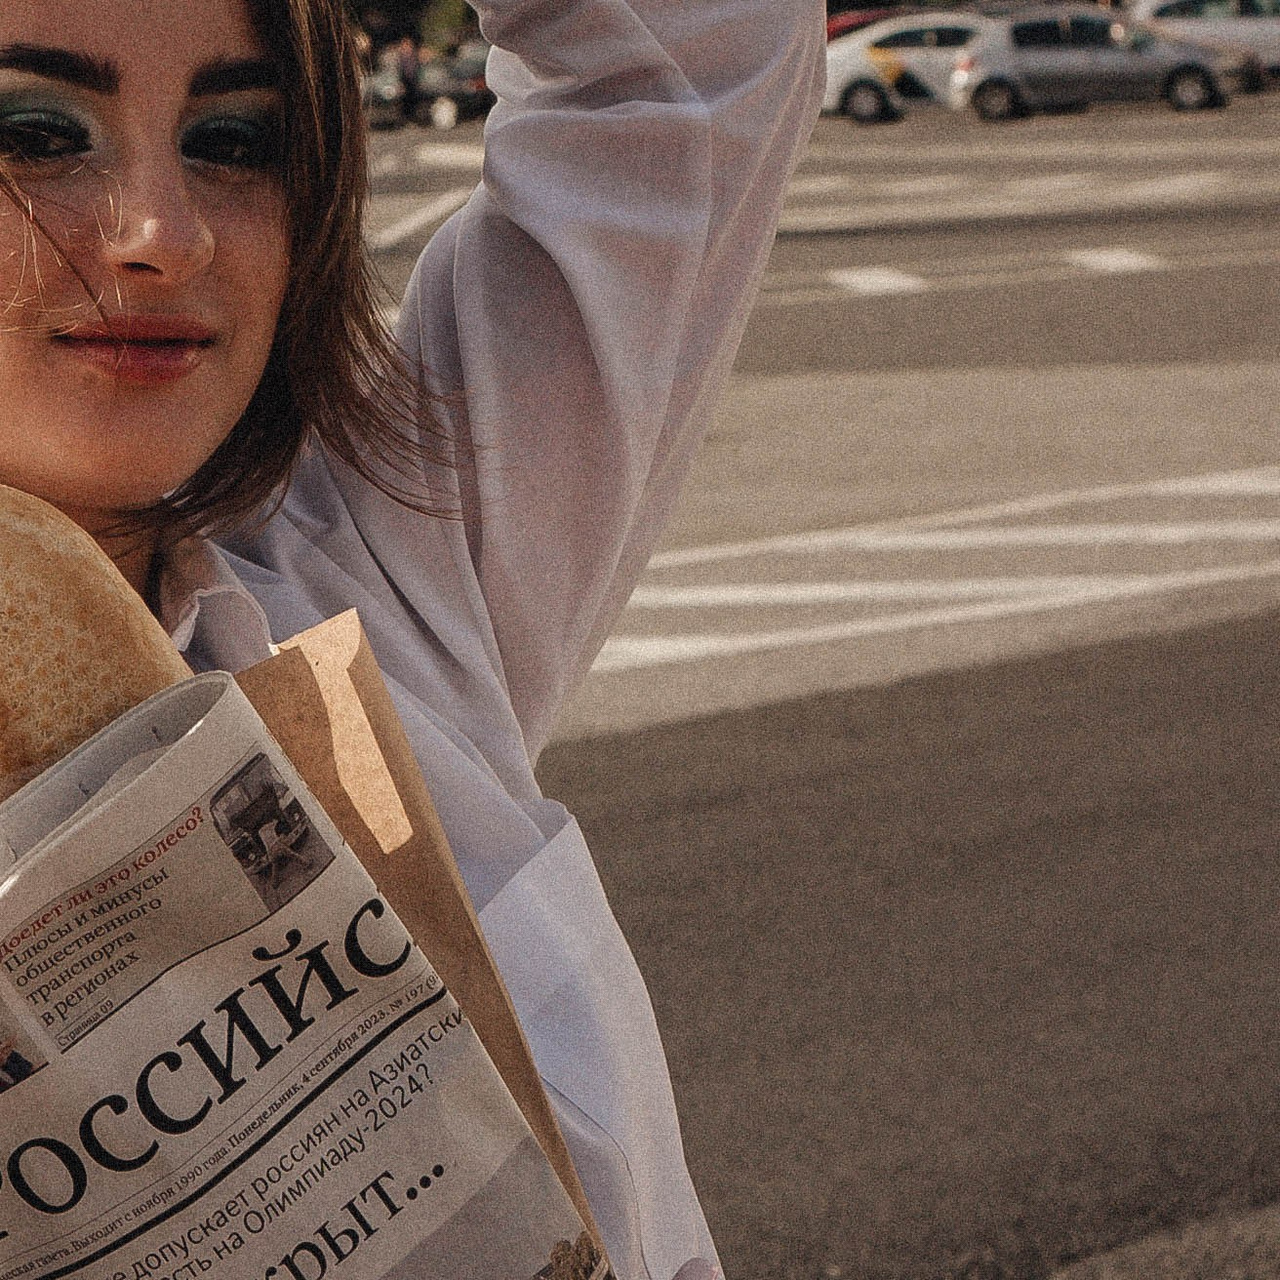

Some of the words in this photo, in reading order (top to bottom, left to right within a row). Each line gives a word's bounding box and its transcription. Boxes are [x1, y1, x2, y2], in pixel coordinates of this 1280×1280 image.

[67, 889, 92, 911] ли
[97, 867, 131, 894] это
[132, 806, 205, 873] колесо?
[3, 921, 73, 974] Плюсы
[74, 913, 89, 928] и
[90, 867, 170, 919] минусы
[16, 898, 163, 988] общественного
[25, 930, 138, 1006] транспорта
[41, 1010, 56, 1027] в
[54, 950, 141, 1022] регионах
[57, 1010, 100, 1046] Страница
[100, 999, 114, 1015] 09
[70, 1222, 123, 1253] Выходит
[131, 1186, 176, 1221] ноября
[175, 1166, 203, 1192] 1990
[227, 1083, 304, 1149] Понедельник,
[301, 1073, 311, 1084] 4
[309, 1034, 361, 1078] сентября
[390, 998, 403, 1013] №
[404, 982, 425, 1002] 197
[213, 1231, 245, 1261] на
[243, 1062, 435, 1236] Олимпиаду-2024?
[250, 1111, 342, 1201] россиян
[340, 1087, 371, 1119] на
